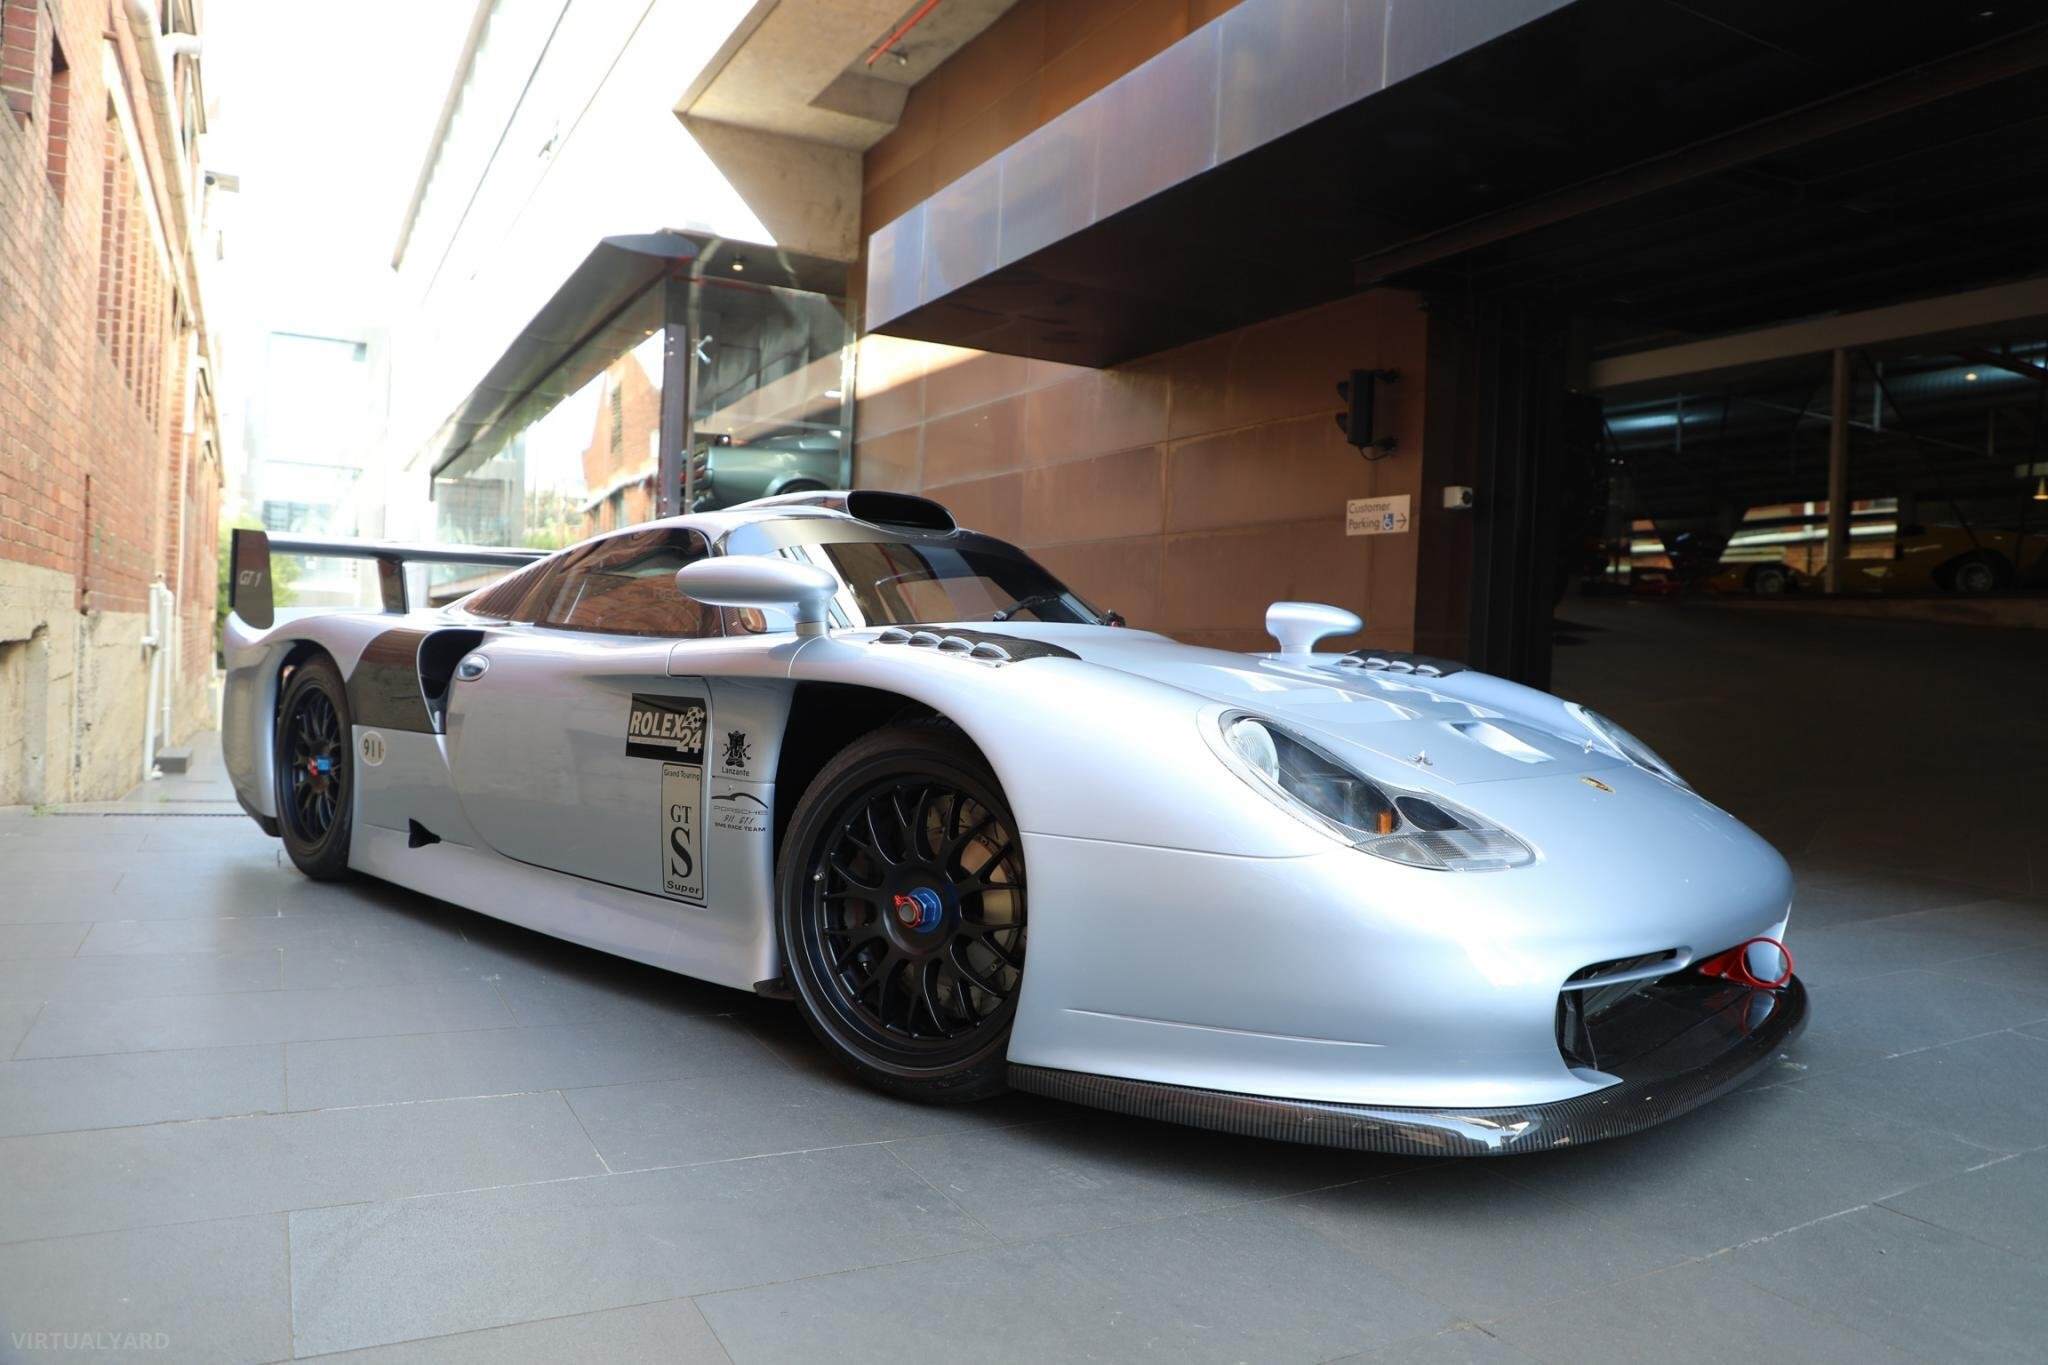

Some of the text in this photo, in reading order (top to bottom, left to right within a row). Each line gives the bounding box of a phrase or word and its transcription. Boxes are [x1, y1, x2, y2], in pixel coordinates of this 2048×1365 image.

[1349, 502, 1391, 514] Customer
[1349, 518, 1381, 531] Parking
[629, 711, 703, 754] ROLEX 24
[663, 768, 700, 781] Grand Touring
[721, 766, 750, 777] Lanzante
[670, 803, 692, 824] GT
[713, 805, 769, 815] PORSCHE
[670, 826, 693, 878] S
[666, 880, 700, 895] Super
